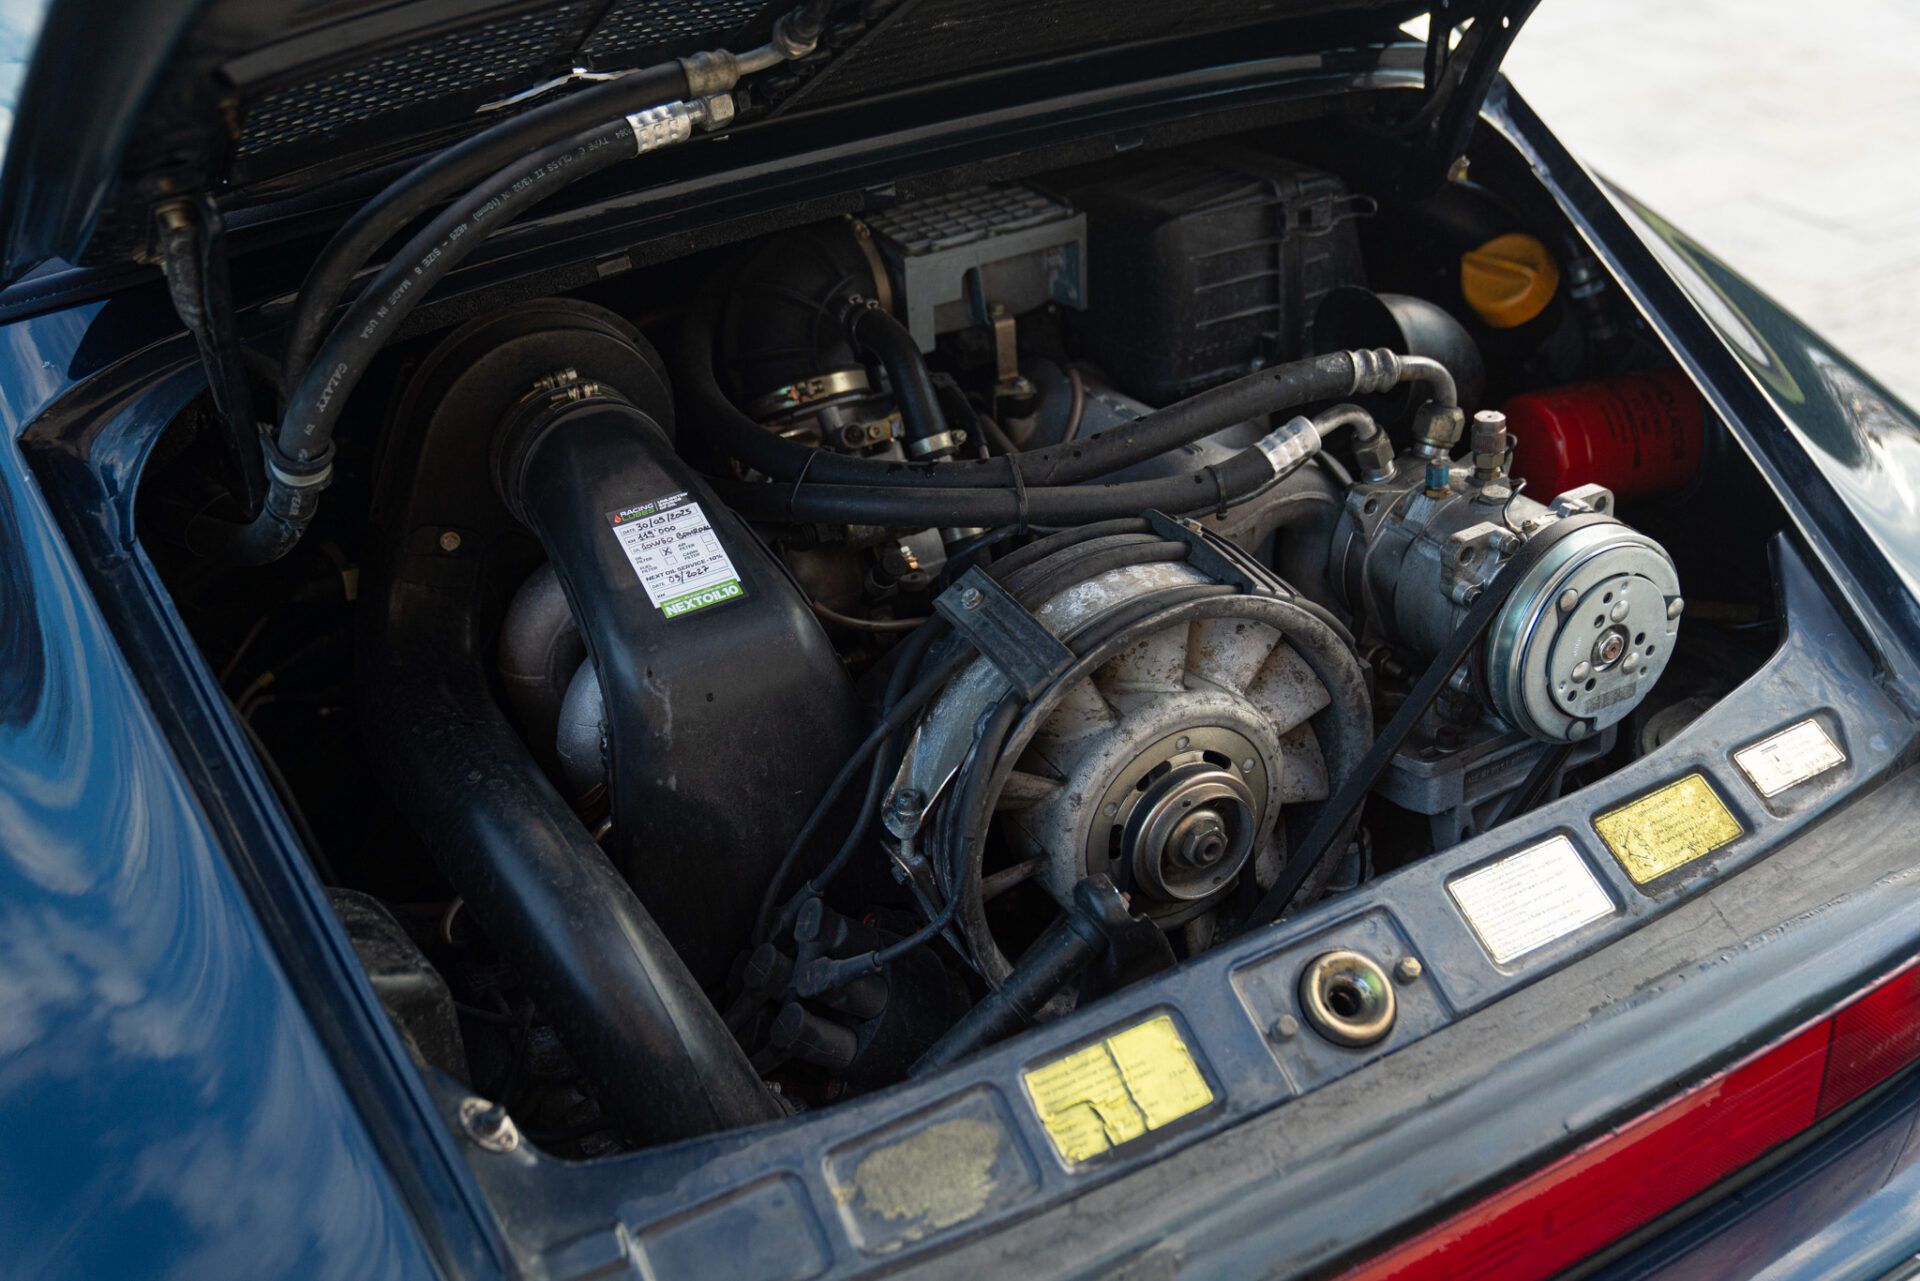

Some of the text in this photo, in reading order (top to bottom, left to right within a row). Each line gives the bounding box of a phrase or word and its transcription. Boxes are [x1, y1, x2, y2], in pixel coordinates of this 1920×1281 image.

[547, 153, 572, 171] CLASS
[473, 198, 500, 222] (10mm)
[422, 248, 441, 268] SIZE
[388, 280, 412, 305] MADE
[377, 306, 389, 318] IN
[360, 320, 378, 339] USA
[316, 363, 348, 412] GALAXY
[620, 502, 654, 516] RACING
[622, 508, 656, 522] LUBES
[646, 571, 664, 582] NEXT
[665, 568, 676, 576] OIL
[678, 558, 706, 572] SERVICE
[665, 584, 739, 616] NEXTOIL10
